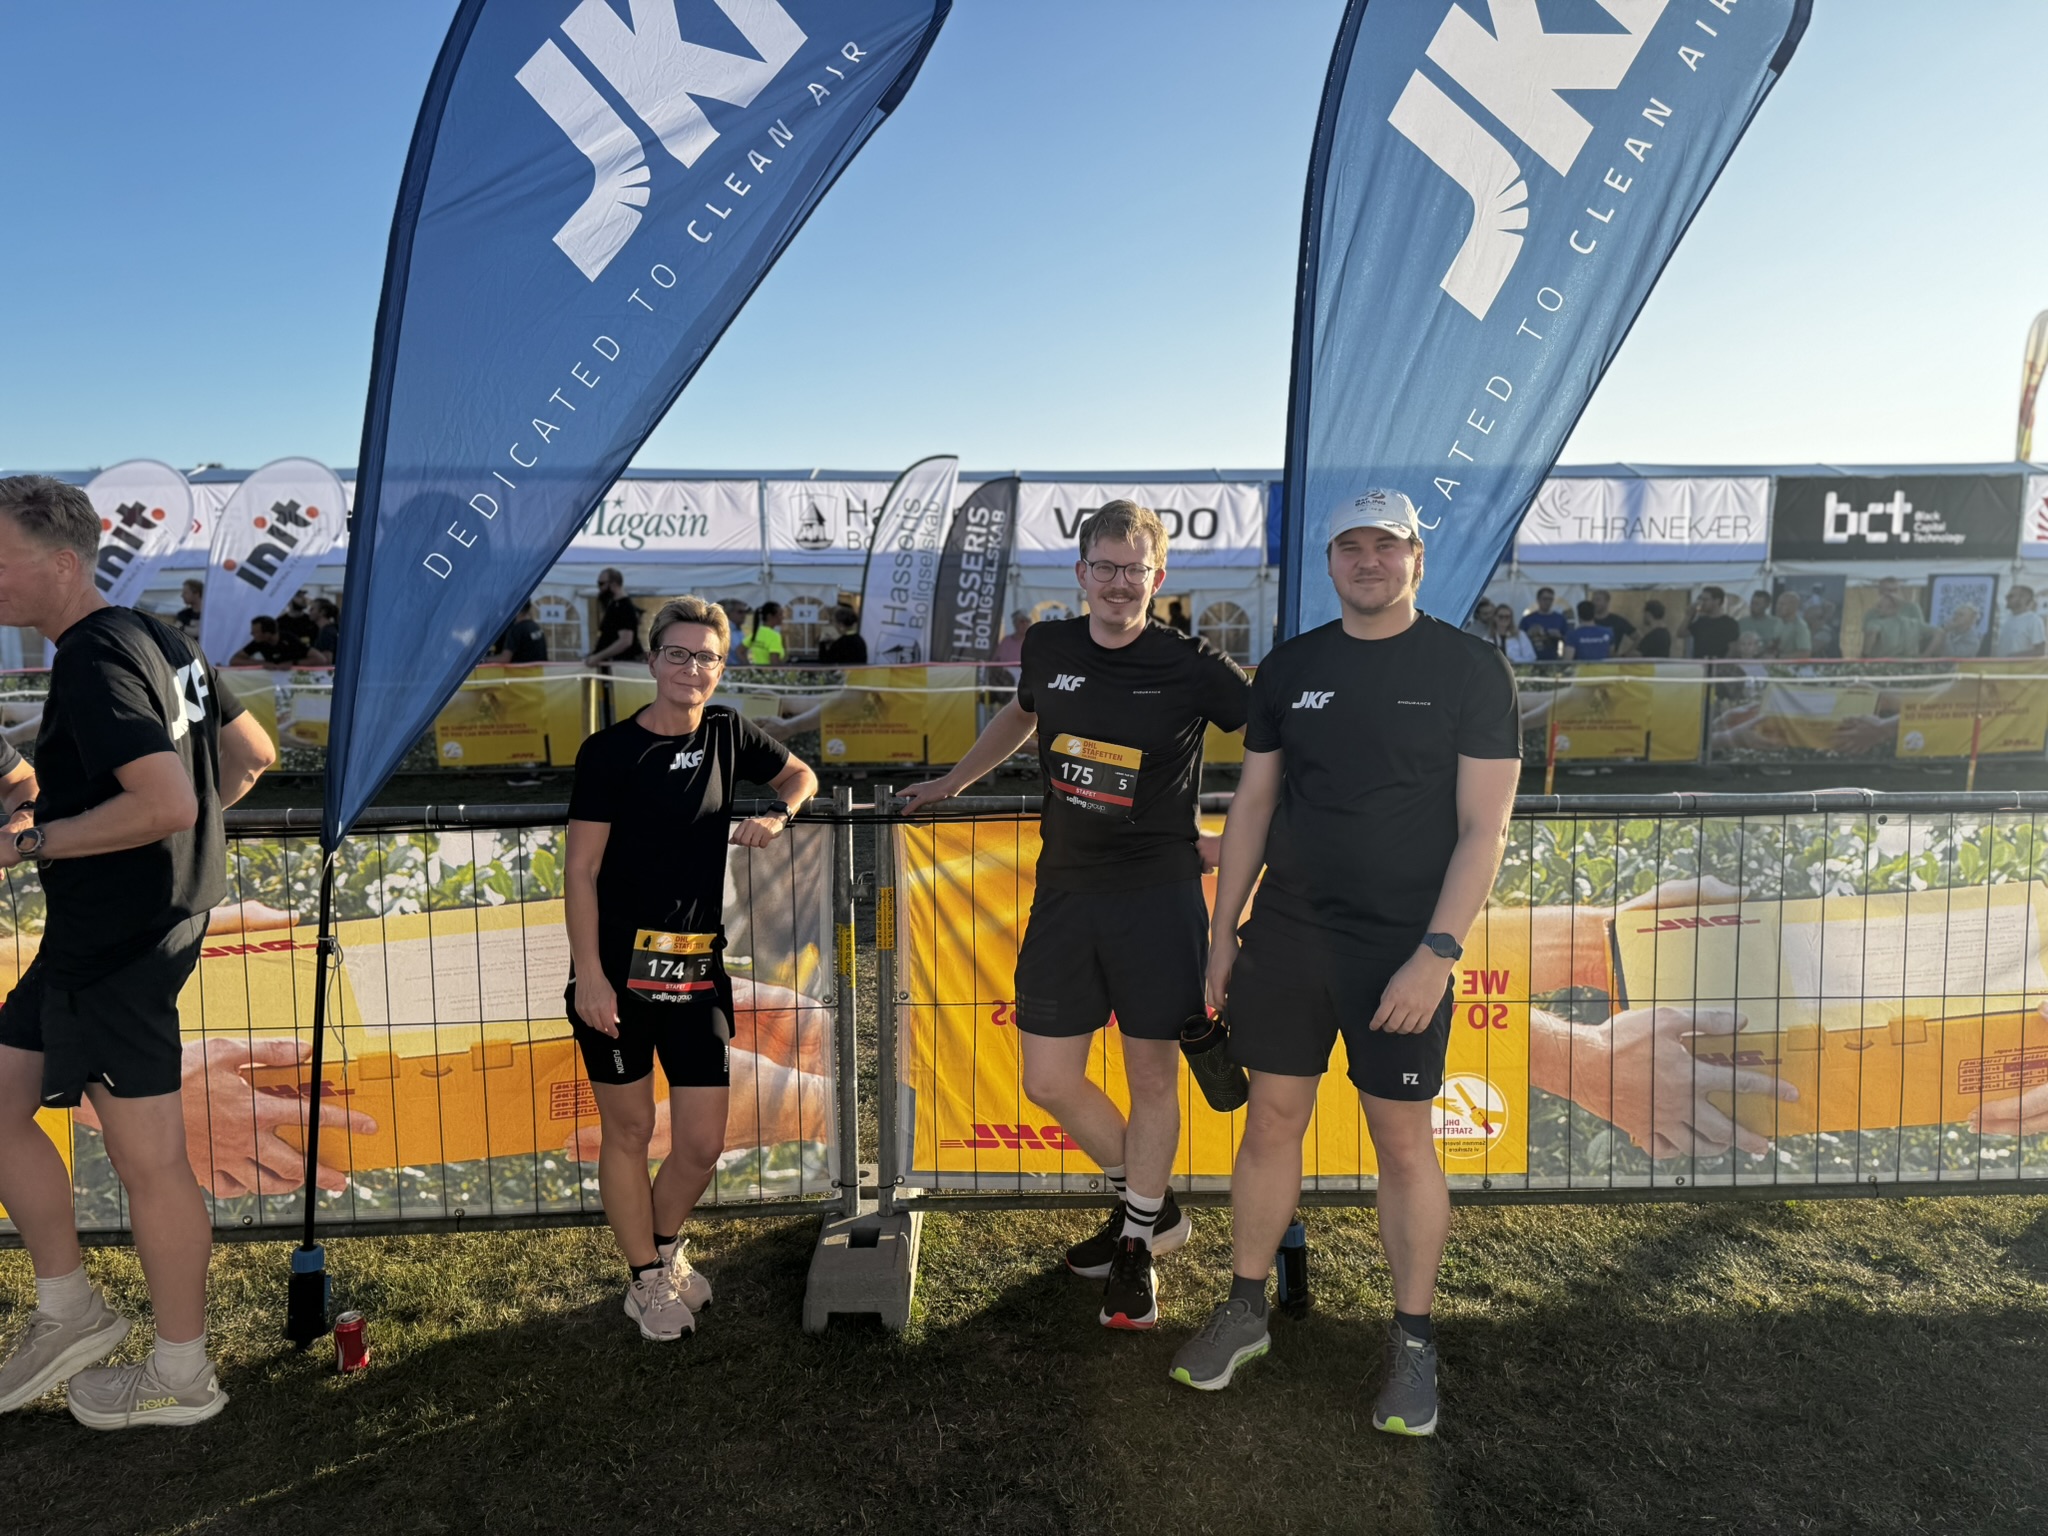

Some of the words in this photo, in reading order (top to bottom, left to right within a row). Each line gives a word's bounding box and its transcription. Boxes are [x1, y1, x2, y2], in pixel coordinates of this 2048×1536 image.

[1415, 375, 1513, 531] CATED
[1516, 286, 1564, 340] TO
[1568, 97, 1673, 255] CLEAN
[1677, 0, 1738, 72] AIR
[423, 335, 620, 579] DEDICATED
[627, 263, 677, 312] TO
[687, 118, 795, 244] CLEAN
[806, 41, 867, 106] AIR
[1054, 507, 1219, 540] VDO
[1572, 515, 1753, 540] THRANEKÆR
[1823, 490, 1912, 543] bct
[881, 497, 922, 627] Hasseris
[908, 500, 940, 630] Boligselskab
[952, 506, 990, 648] HASSERIS
[974, 509, 1006, 650] BOLIGSELSKAB
[1047, 673, 1086, 692] JKF
[1291, 691, 1335, 709] JKF
[1082, 748, 1123, 761] STAFETTEN
[1083, 741, 1098, 749] DHL
[669, 749, 705, 770] JKF
[1061, 762, 1094, 785] 175
[1118, 779, 1128, 790] 5
[1076, 788, 1097, 797] STAFET
[648, 959, 685, 979] 174
[700, 964, 707, 976] 5
[612, 1049, 625, 1074] FUSION
[1402, 1073, 1420, 1085] FZ
[135, 1396, 179, 1411] HOKA
